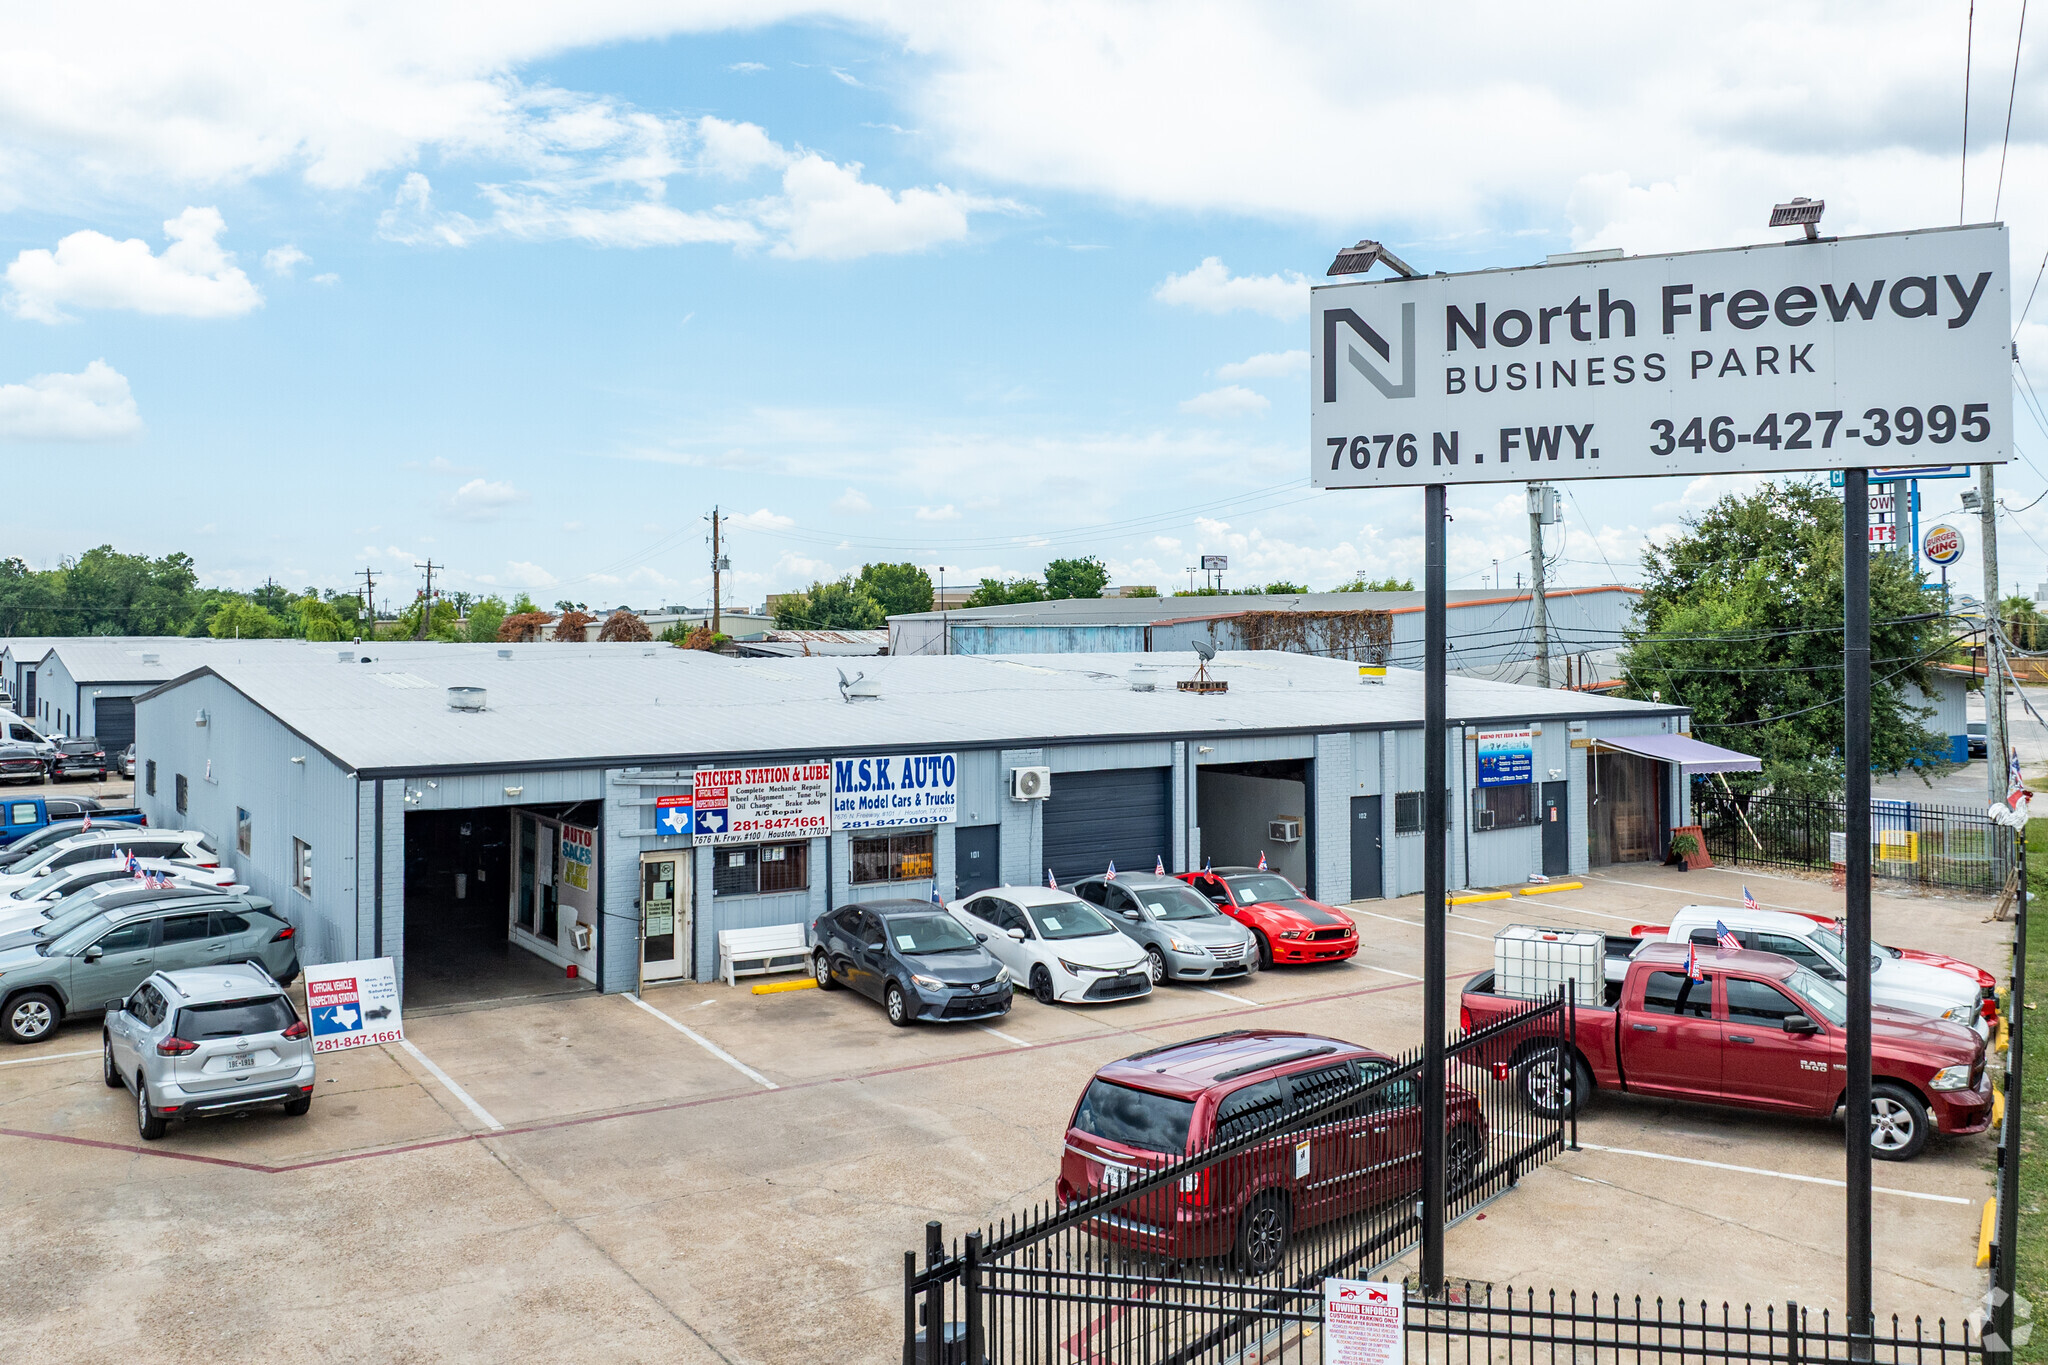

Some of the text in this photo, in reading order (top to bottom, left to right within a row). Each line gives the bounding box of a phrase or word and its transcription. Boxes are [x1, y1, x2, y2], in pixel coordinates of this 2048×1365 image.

[1446, 270, 1993, 352] North Freeway
[1446, 343, 1816, 395] BUSINESS PARK
[1327, 432, 1418, 471] 7676
[1501, 423, 1600, 461] FWY.
[1649, 403, 1991, 456] 346-427-3995
[1927, 532, 1956, 547] BURGER
[1928, 540, 1958, 556] KING
[695, 765, 830, 787] STICKER STATION & LUBE
[835, 755, 955, 792] M.S.K. AUTO
[753, 794, 784, 802] Alignment
[834, 791, 954, 812] Late Model Cars & Trucks
[733, 816, 825, 832] 281-847-1661
[842, 816, 948, 828] 281-847-0030
[563, 824, 592, 847] AUTO
[694, 836, 712, 844] 7676
[714, 834, 722, 842] N.
[744, 832, 760, 840] #100
[808, 827, 829, 836] 77037
[562, 842, 592, 866] SALES
[312, 980, 353, 994] OFFICIAL VEHICLE
[310, 992, 358, 1006] INSPECTION STATION
[316, 1030, 402, 1051] 281-847-1661
[1331, 1302, 1397, 1317] TOWING ENFORCED
